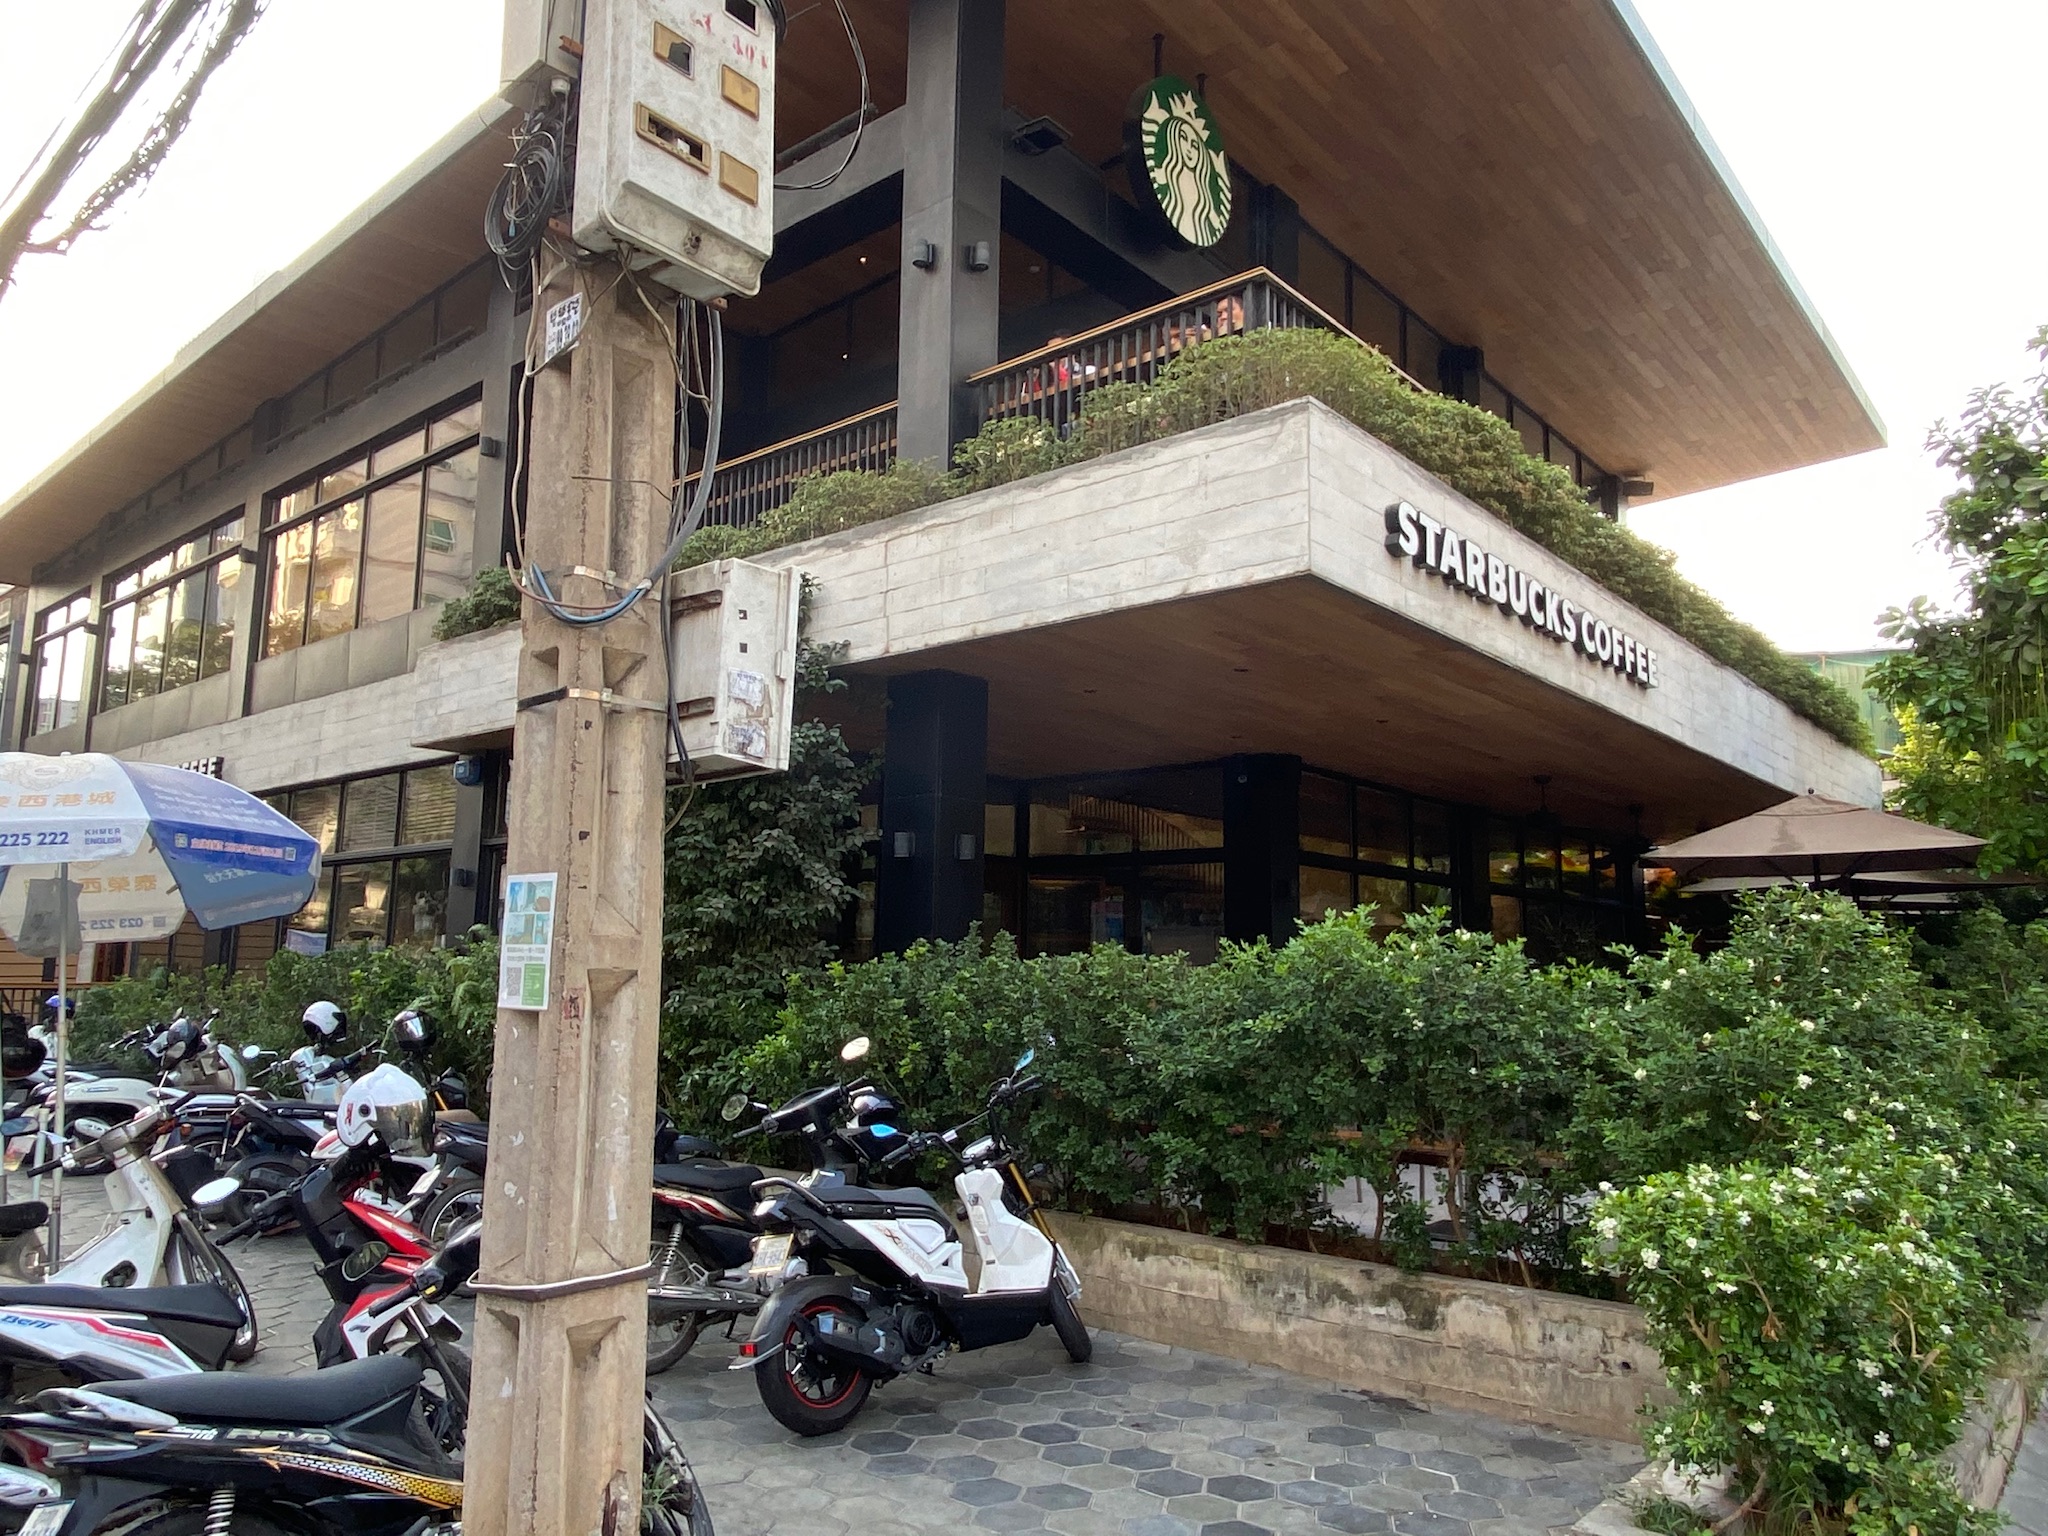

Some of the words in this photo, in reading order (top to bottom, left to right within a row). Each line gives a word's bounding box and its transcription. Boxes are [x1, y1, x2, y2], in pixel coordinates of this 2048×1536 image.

[1388, 501, 1577, 643] STARBUCKS
[1578, 611, 1660, 688] COFFEE
[84, 828, 121, 836] KHMER
[0, 833, 32, 847] 225
[36, 832, 69, 846] 222
[84, 836, 122, 845] ENGLISH
